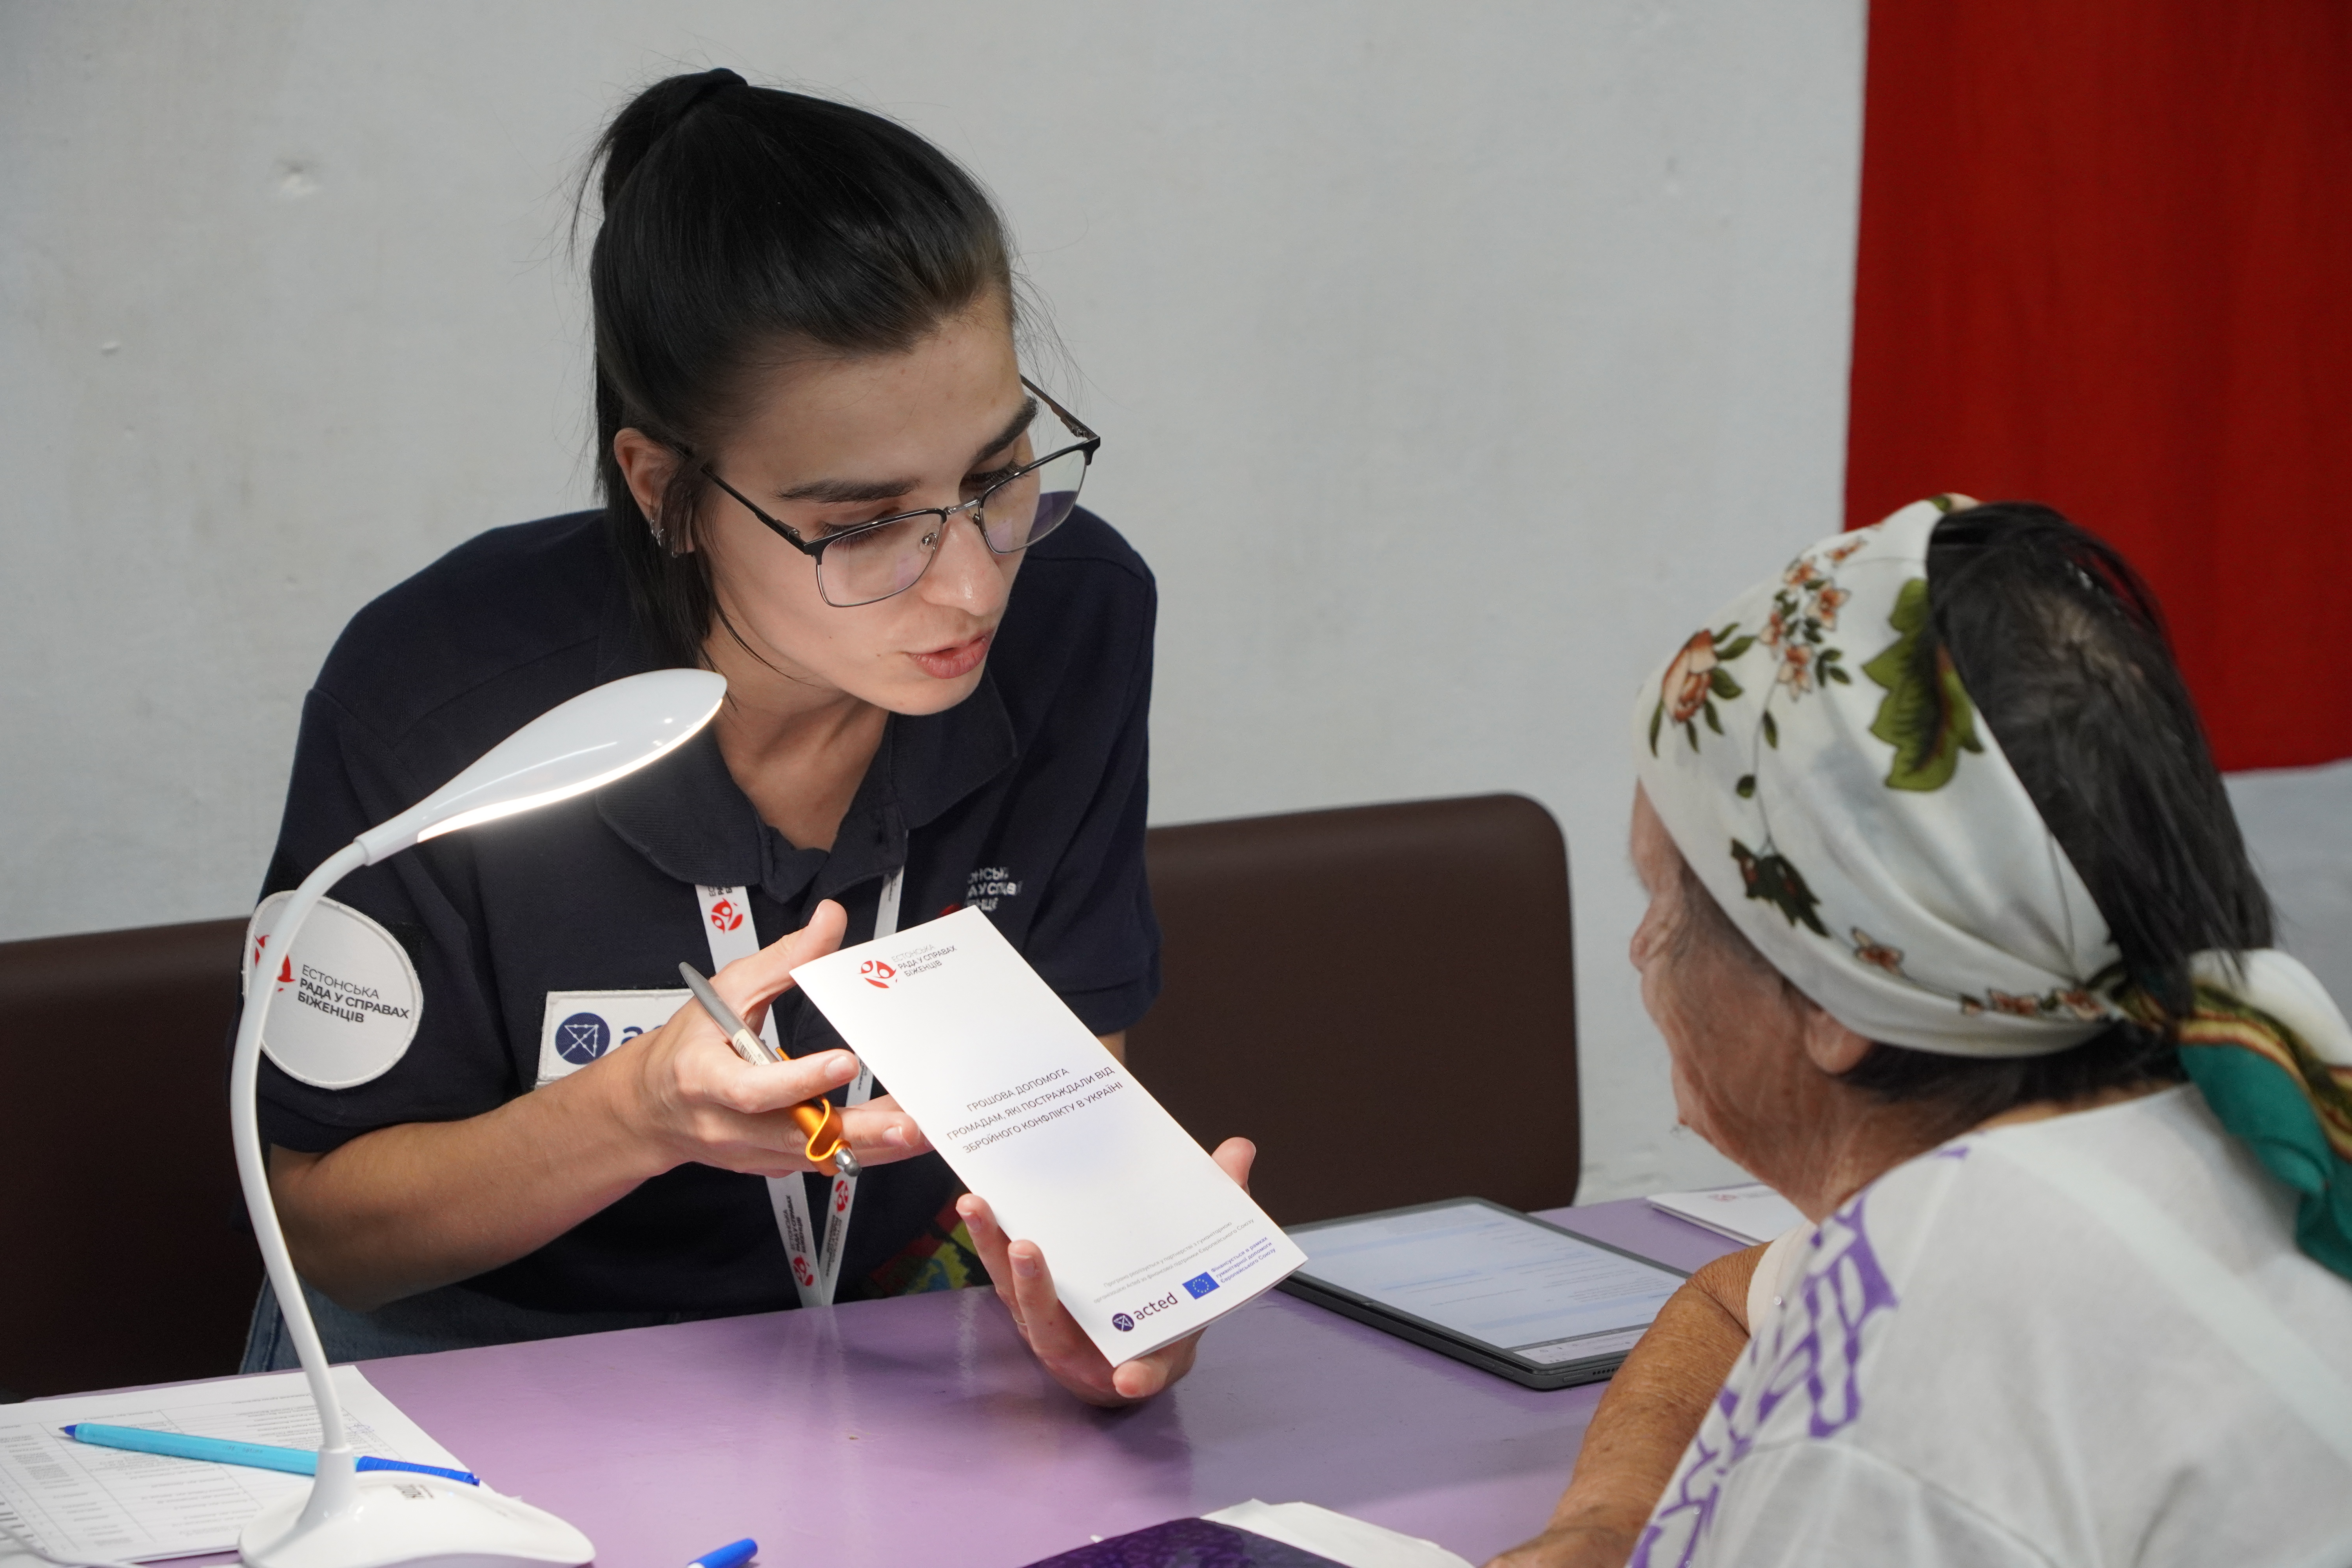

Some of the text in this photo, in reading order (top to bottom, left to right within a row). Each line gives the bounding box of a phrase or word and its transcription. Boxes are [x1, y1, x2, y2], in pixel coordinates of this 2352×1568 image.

[891, 944, 935, 962] ЕСТОНСЬКА
[898, 959, 918, 969] РАДА
[923, 945, 957, 961] СПРАВАХ
[904, 960, 942, 976] БІЖЕНЦІВ
[299, 977, 410, 1019] РАДА У СПРАВАХ
[302, 964, 379, 999] ЕСТОНСЬКА
[298, 991, 364, 1023] БІЖЕНЦІВ
[947, 1067, 1115, 1140] ГРОМАДАМ, ЯКІ ПОСТРАЖДАЛИ ВІД
[967, 1068, 1070, 1112] ГРОШОВА ДОПОМОГА
[963, 1125, 1021, 1153] ЗБРОЙНОГО
[1021, 1103, 1074, 1130] КОНФЛІКТУ
[1083, 1082, 1123, 1103] УКРАЇНІ
[1198, 1229, 1237, 1253] Європейського
[1237, 1218, 1254, 1230] Союзу
[1103, 1274, 1129, 1287] Програма
[1197, 1222, 1232, 1244] гуманітарною
[1211, 1251, 1245, 1272] Фінансується
[1250, 1237, 1268, 1250] рамках
[1216, 1242, 1272, 1278] гуманітарної допомоги
[1221, 1248, 1276, 1283] Європейського Союзу
[1134, 1292, 1178, 1320] acted
